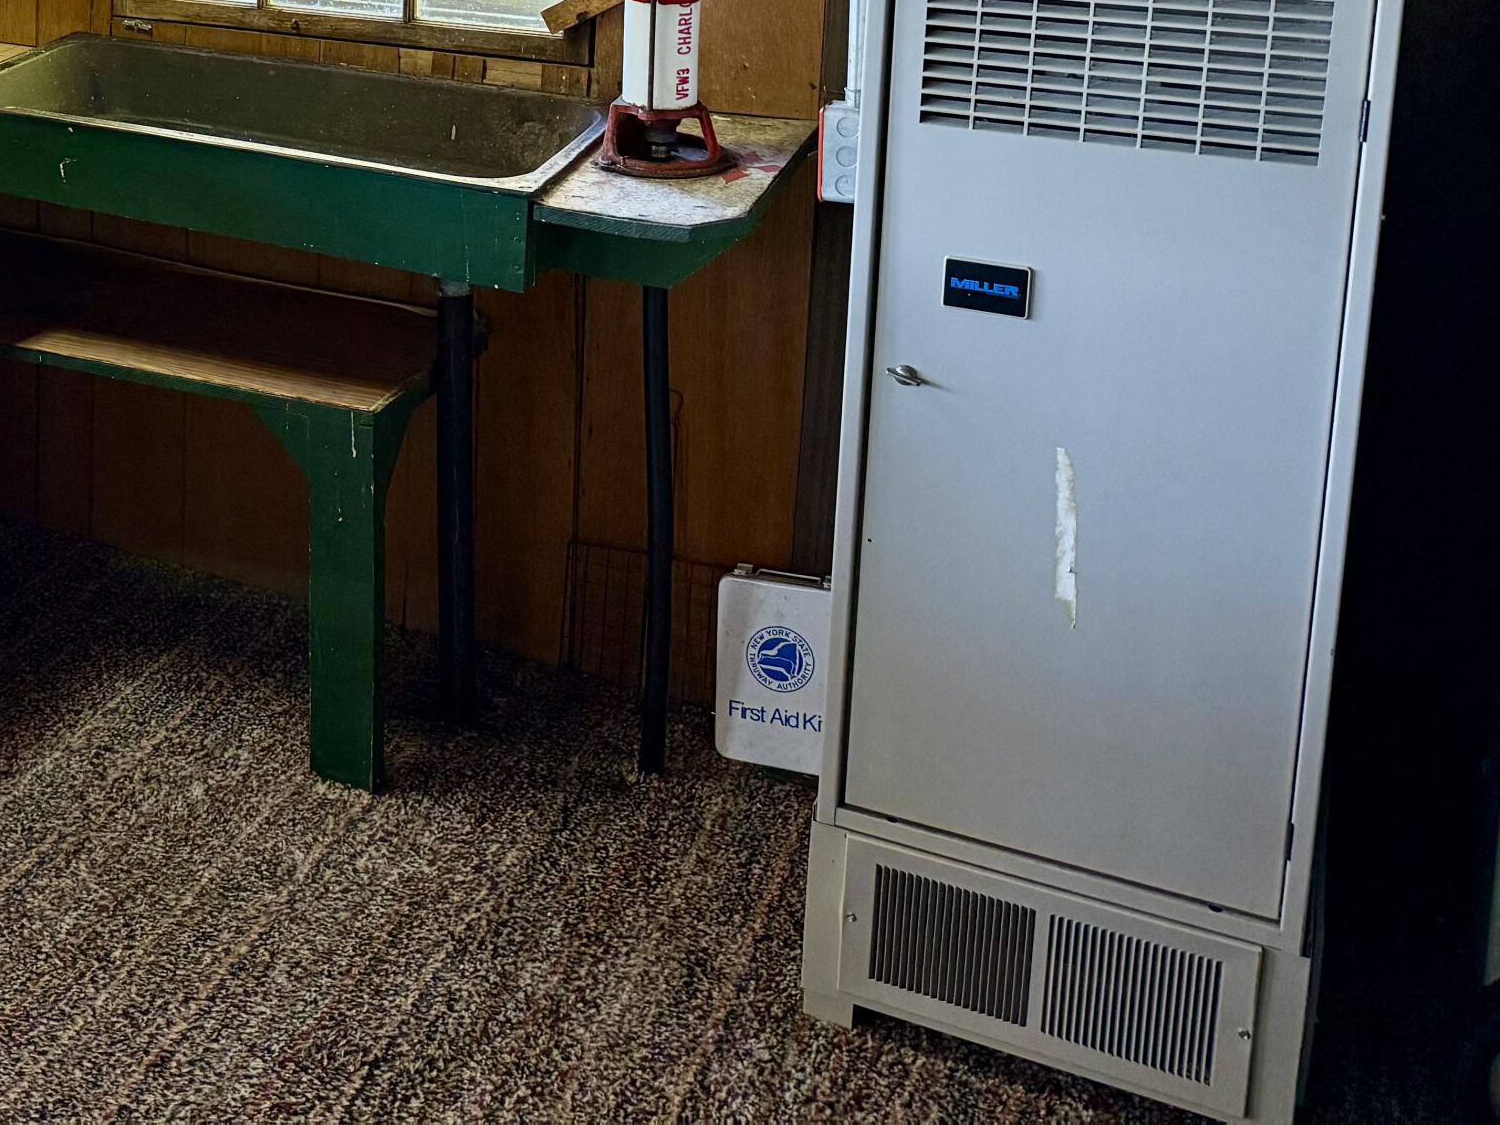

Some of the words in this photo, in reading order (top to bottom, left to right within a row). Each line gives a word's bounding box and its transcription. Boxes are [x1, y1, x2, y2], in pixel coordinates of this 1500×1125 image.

[675, 67, 690, 101] VFW3
[950, 277, 1019, 296] MILLER
[750, 633, 765, 650] NEW
[766, 629, 791, 638] YORK
[791, 635, 811, 657] STATE
[749, 653, 773, 686] THRUWAY
[776, 661, 812, 690] AUTHORITY
[728, 699, 767, 723] First
[770, 708, 799, 729] Aid
[803, 712, 823, 733] Ki
